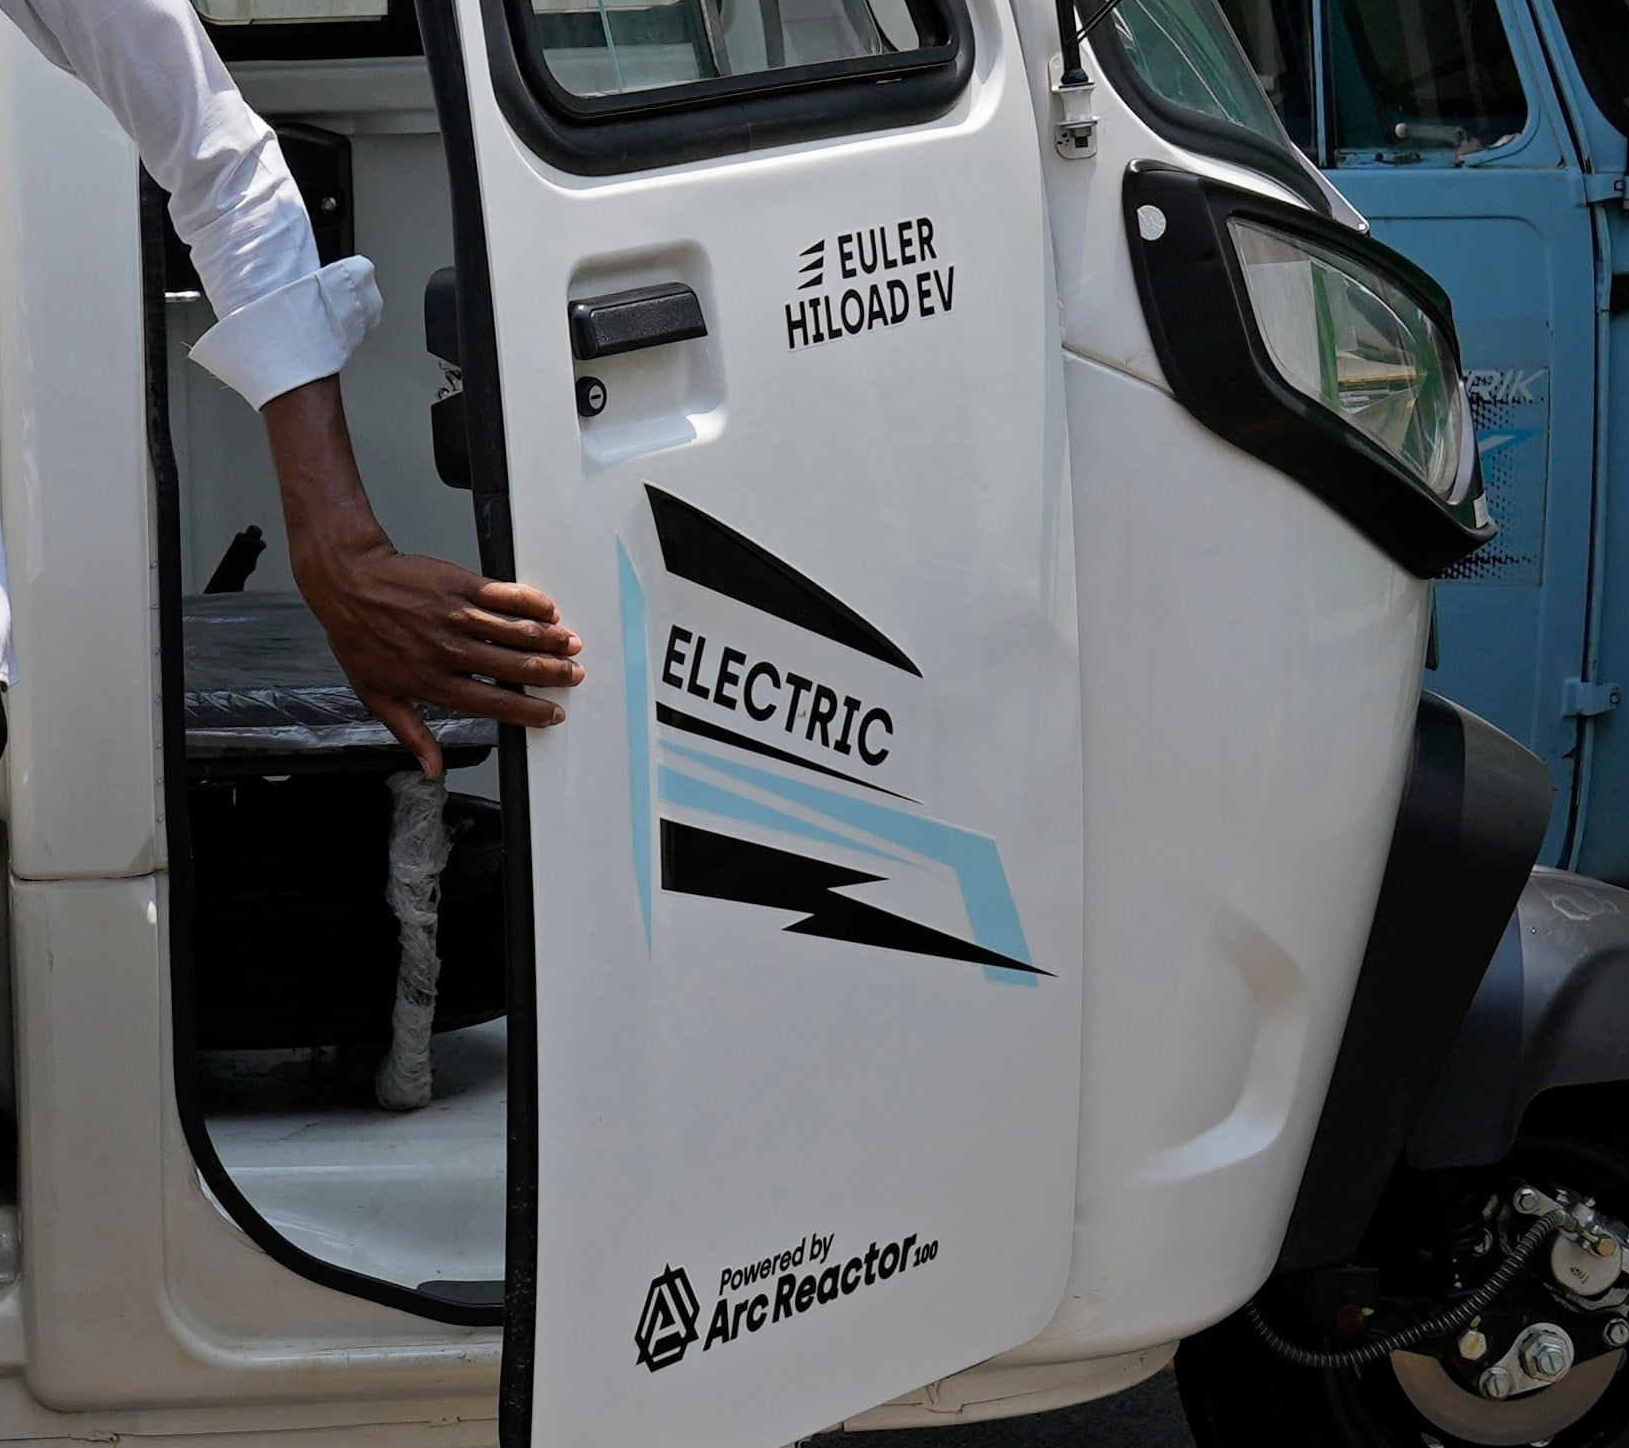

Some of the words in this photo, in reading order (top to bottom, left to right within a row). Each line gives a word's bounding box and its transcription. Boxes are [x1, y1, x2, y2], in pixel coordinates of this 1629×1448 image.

[837, 217, 937, 279] EULER
[785, 279, 909, 349] HILOAD
[916, 266, 954, 318] EV
[1462, 369, 1547, 402] RIK
[661, 624, 894, 767] ELECTRIC
[719, 1236, 807, 1296] Powered
[809, 1232, 835, 1264] by
